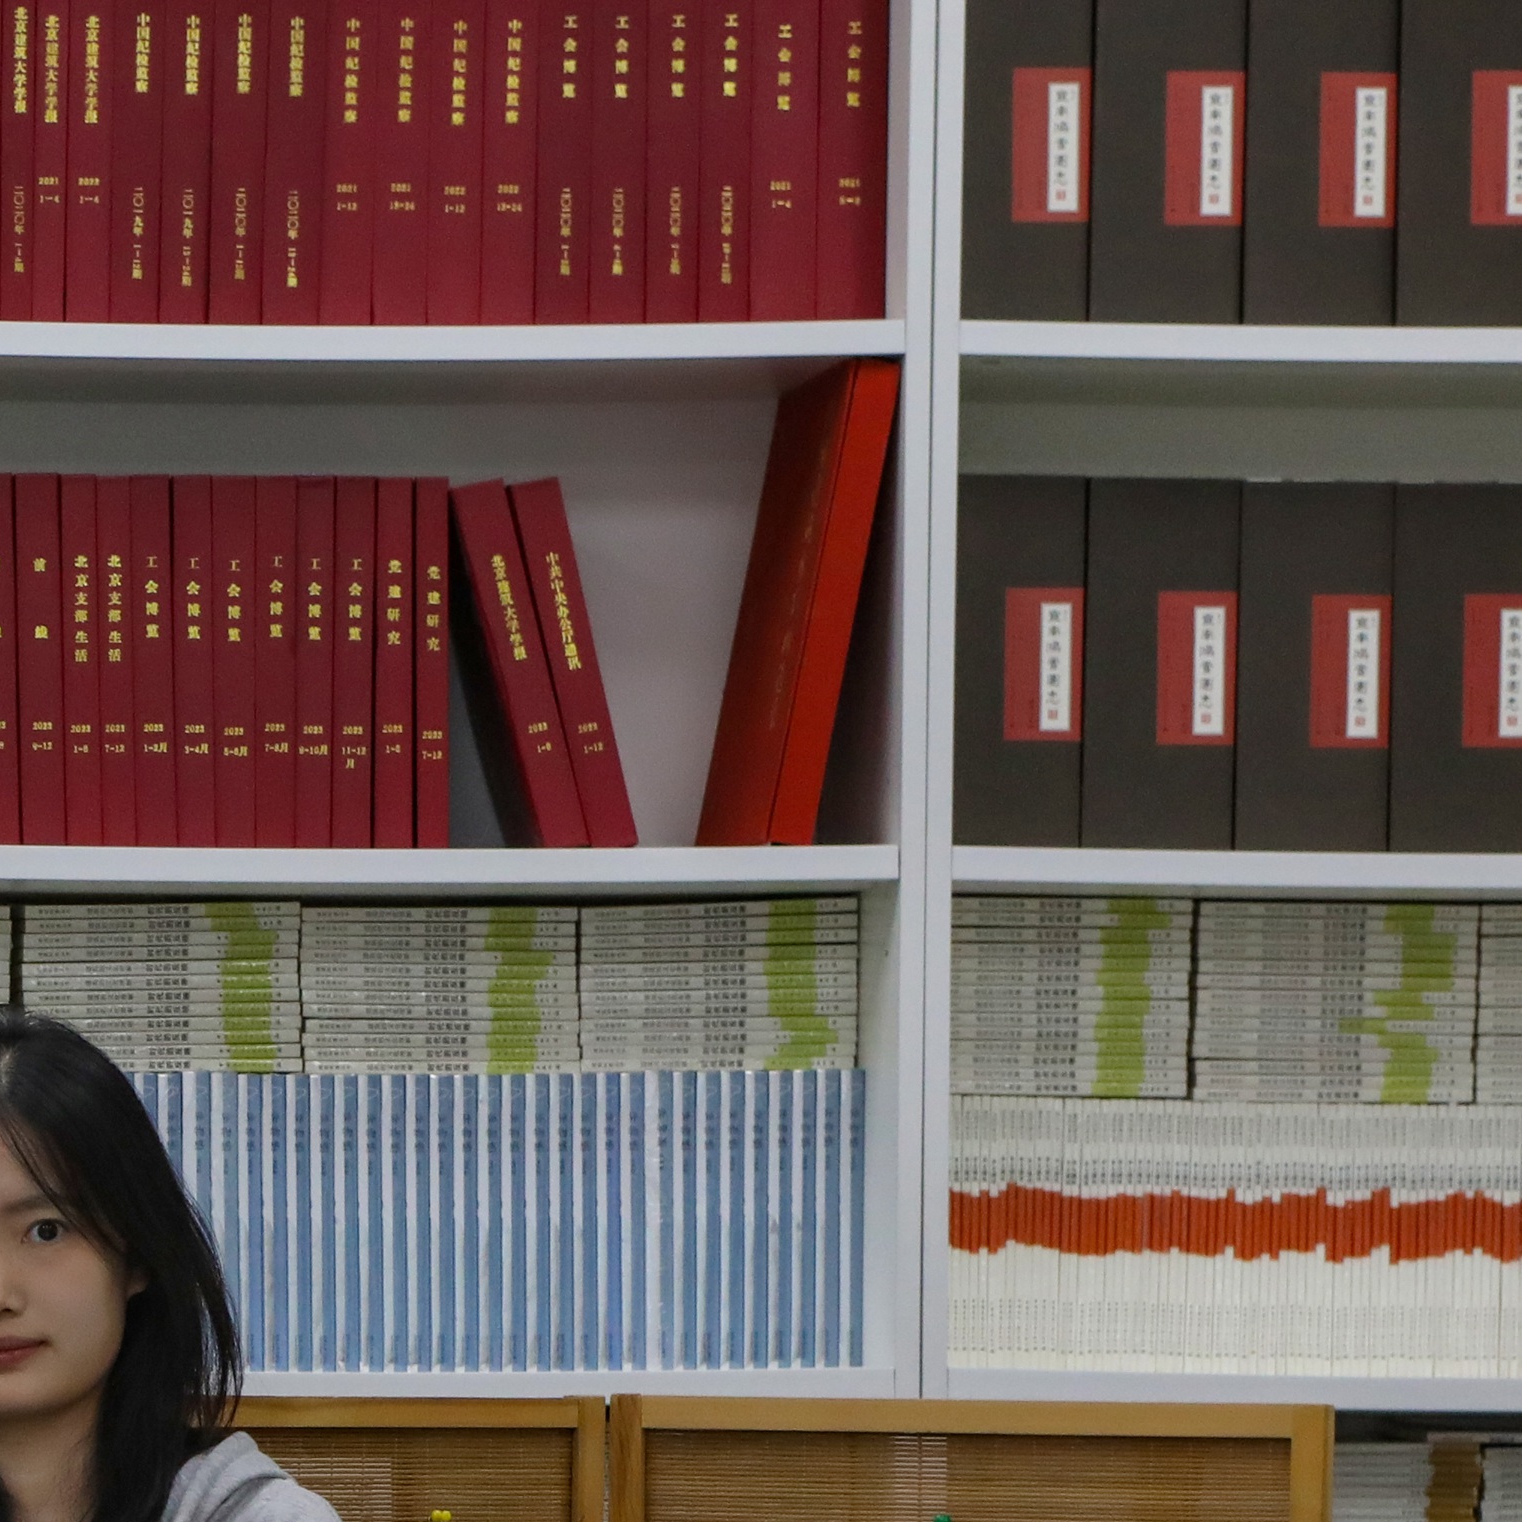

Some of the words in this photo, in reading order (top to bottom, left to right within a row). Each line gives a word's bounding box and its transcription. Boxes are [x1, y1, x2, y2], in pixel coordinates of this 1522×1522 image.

[74, 555, 89, 663] 北京支部生活
[107, 554, 123, 662] 北京支部生活
[386, 559, 403, 645] 党建研究
[426, 565, 441, 652] 党建研究
[490, 553, 527, 662] 北京建筑大学学报
[545, 551, 583, 671] 中共中央办公厅通讯
